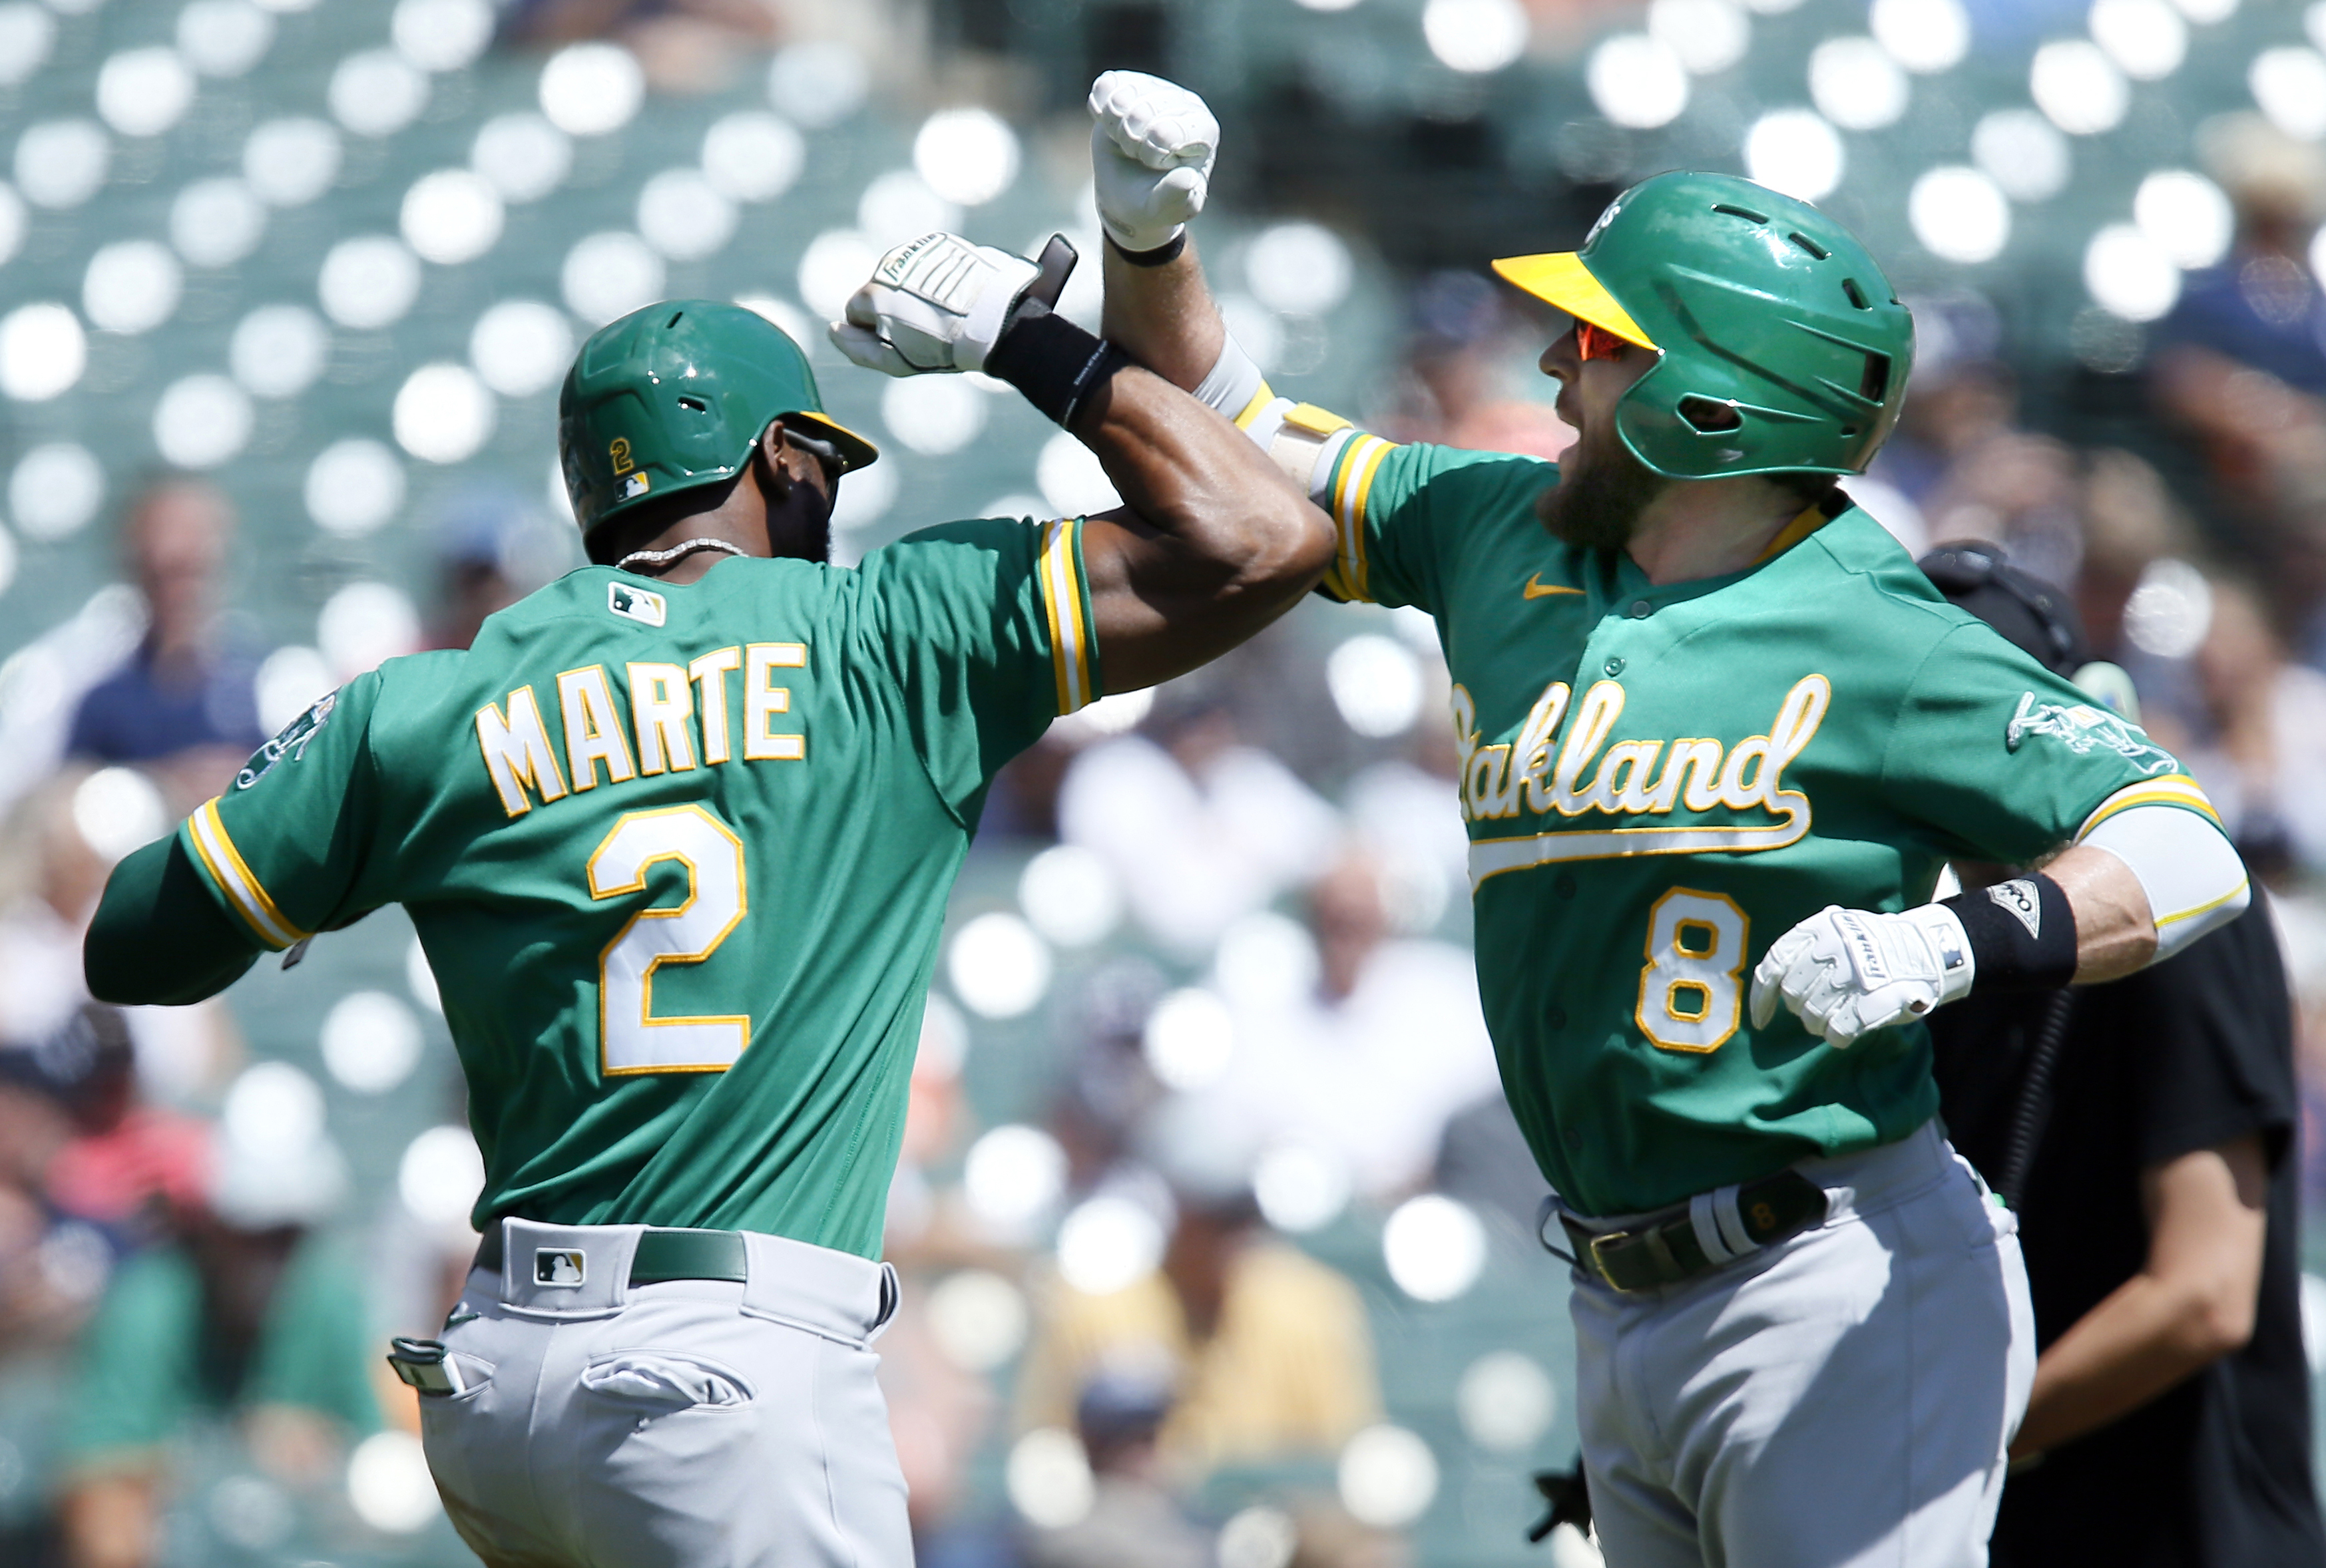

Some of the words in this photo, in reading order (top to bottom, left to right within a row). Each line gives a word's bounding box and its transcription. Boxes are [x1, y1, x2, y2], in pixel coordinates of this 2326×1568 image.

[609, 437, 635, 477] 2
[475, 642, 807, 819] MARTE
[585, 803, 752, 1078] 2
[1634, 884, 1751, 1054] 8
